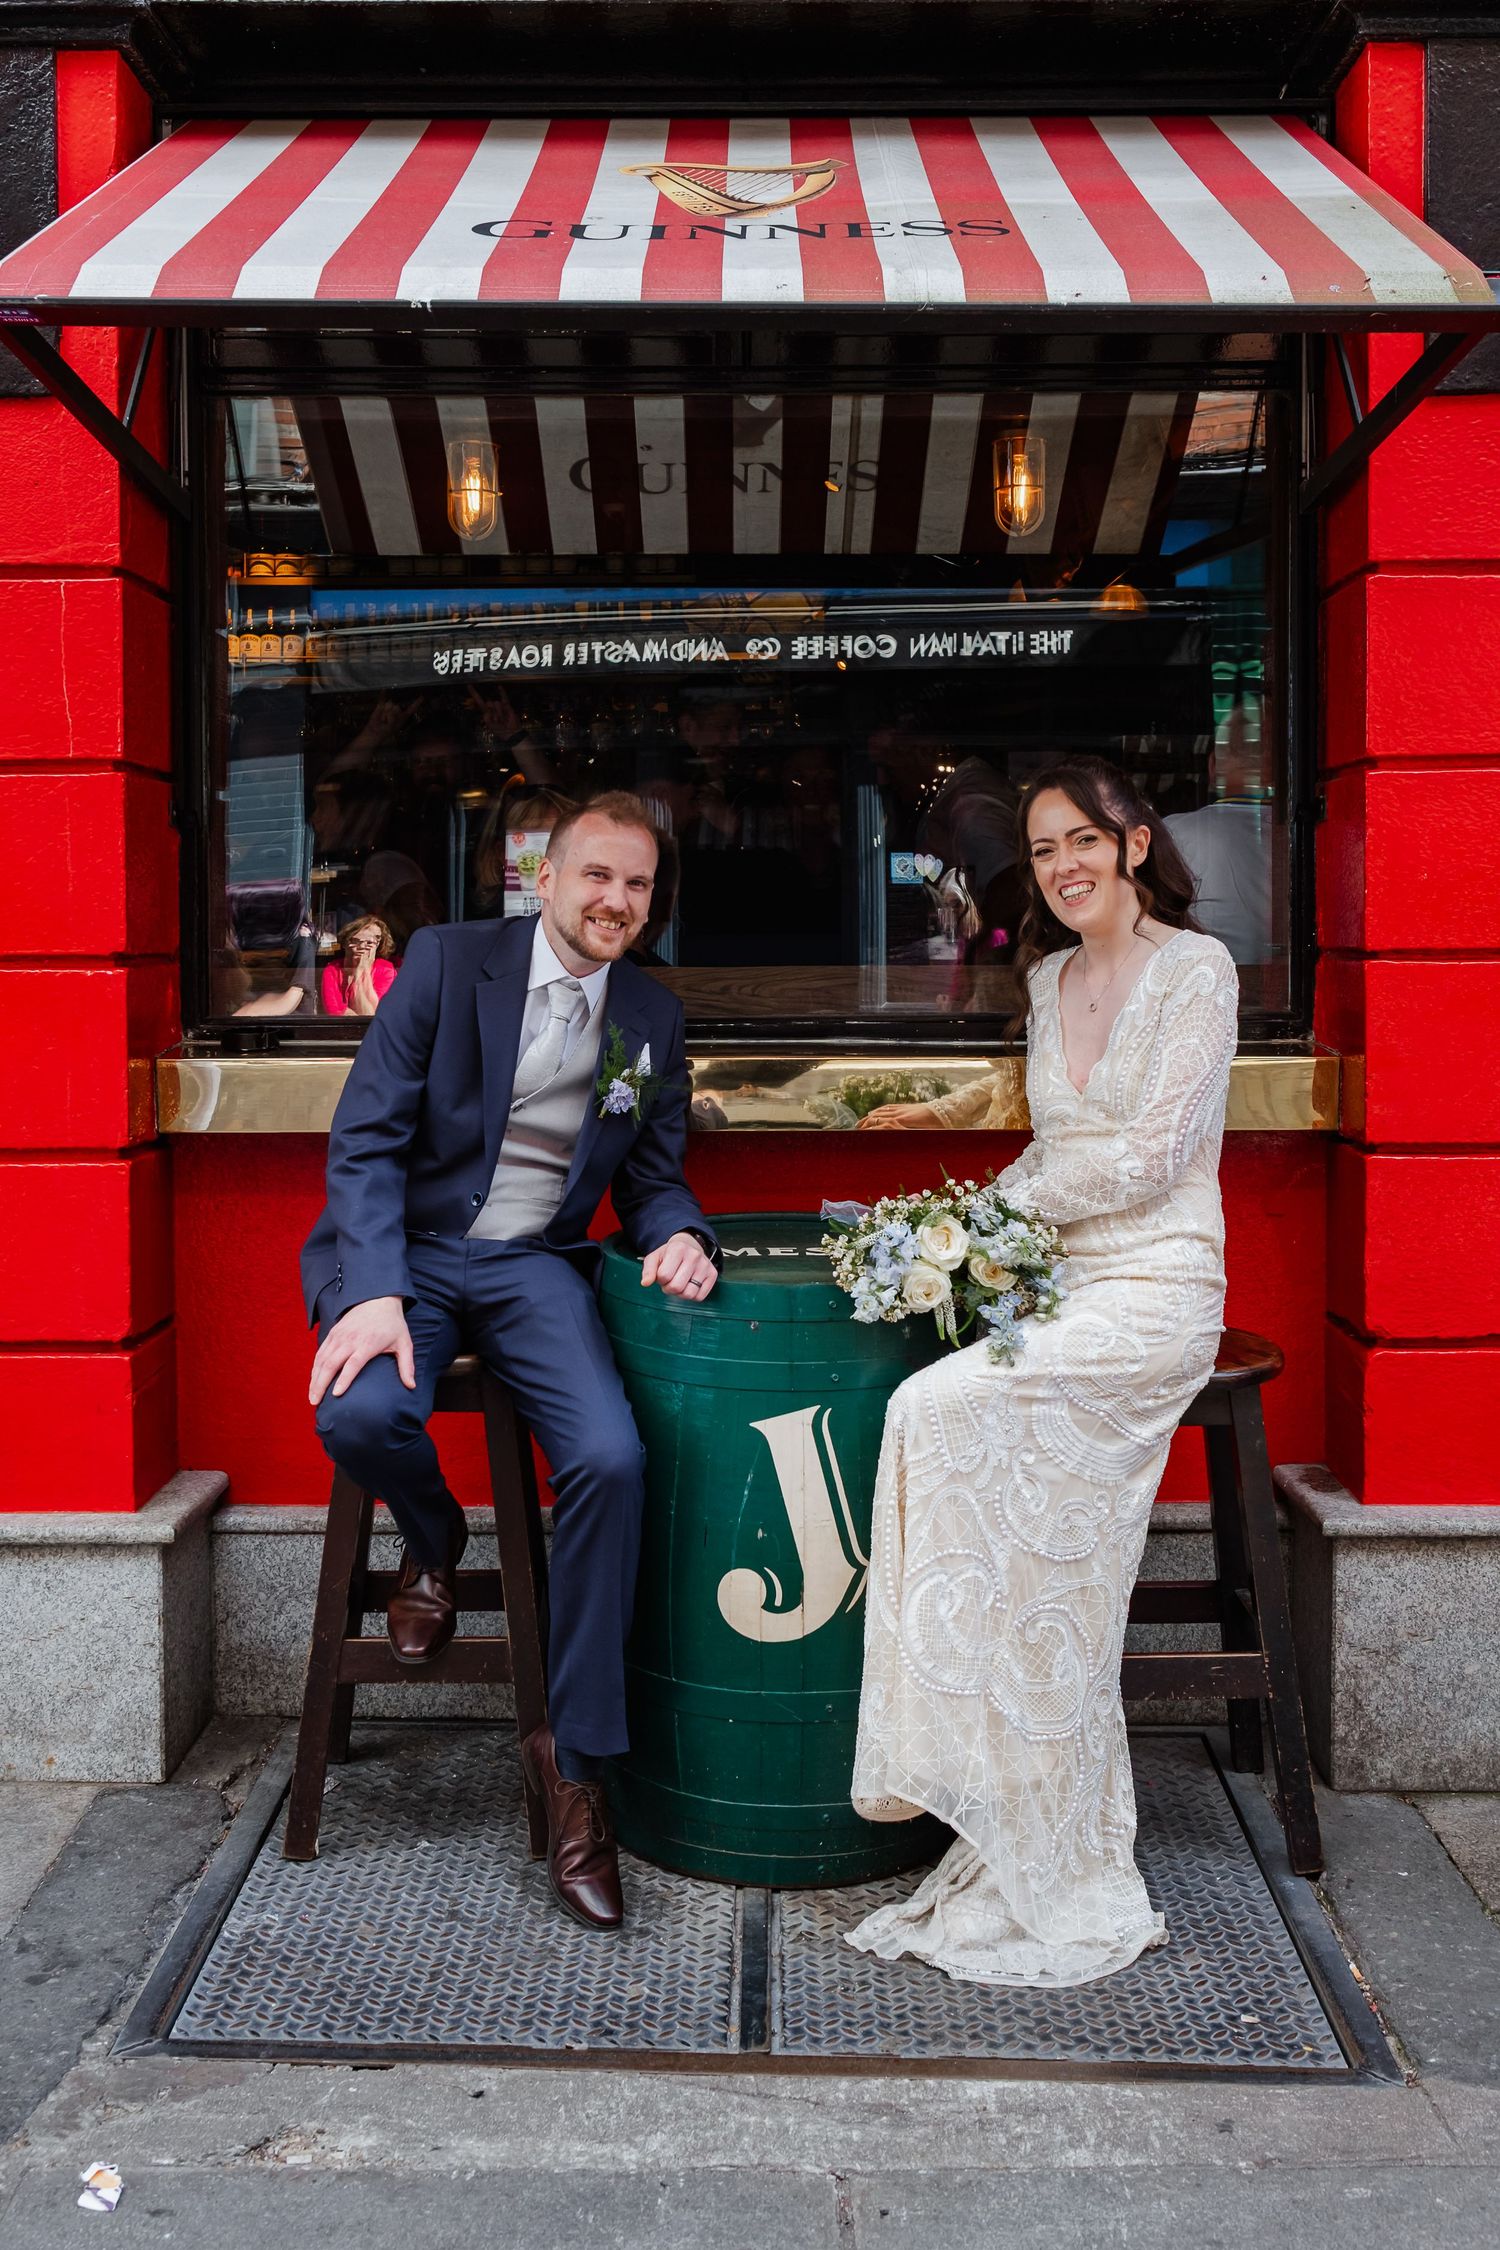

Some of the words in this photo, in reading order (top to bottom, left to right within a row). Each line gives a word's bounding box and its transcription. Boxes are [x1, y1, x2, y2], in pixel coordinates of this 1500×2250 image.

[471, 219, 1011, 241] GUINNESS
[721, 1247, 833, 1257] MES
[717, 1404, 869, 1643] J
